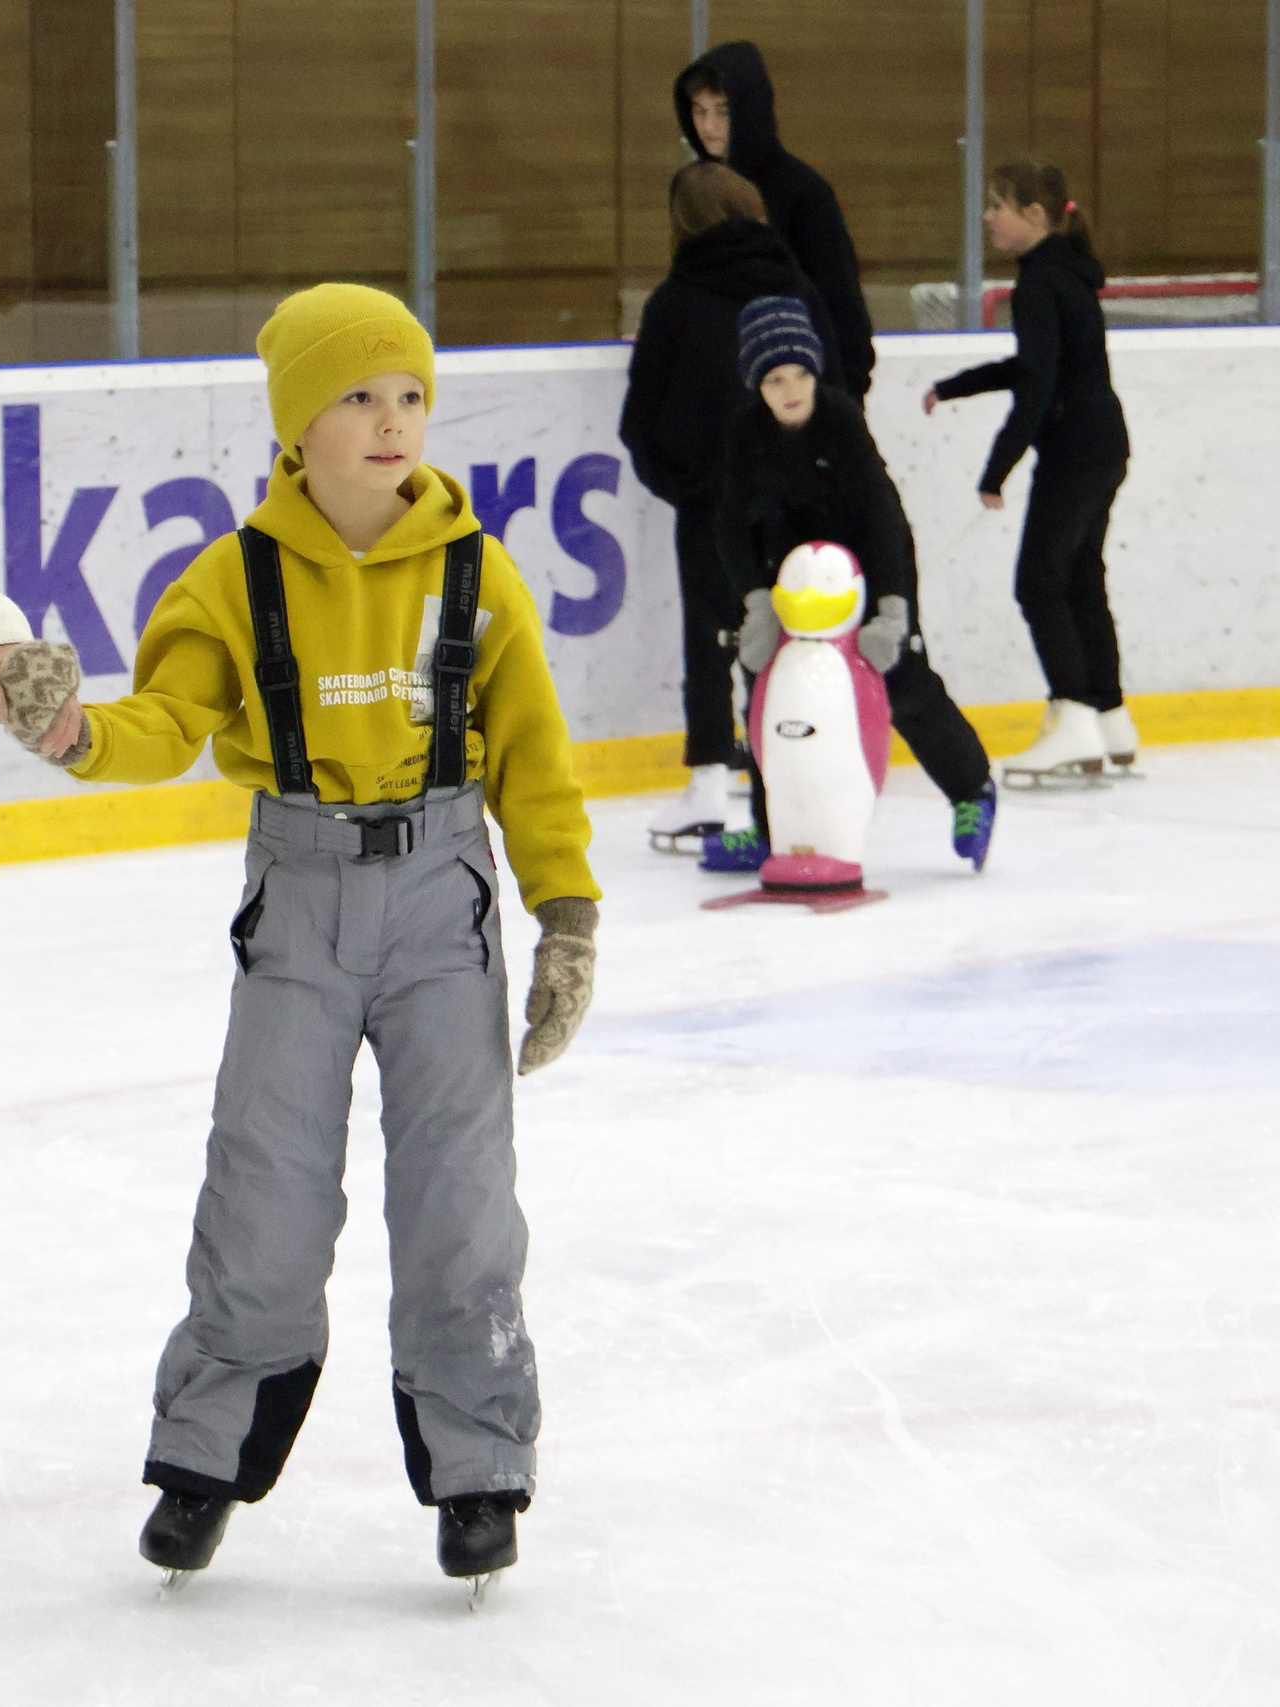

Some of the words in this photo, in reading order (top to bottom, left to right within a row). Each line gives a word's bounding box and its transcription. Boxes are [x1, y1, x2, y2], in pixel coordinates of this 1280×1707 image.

[317, 670, 386, 691] SKATEBOARD
[319, 685, 388, 707] SKATEBOARD
[395, 777, 419, 789] LEGAL
